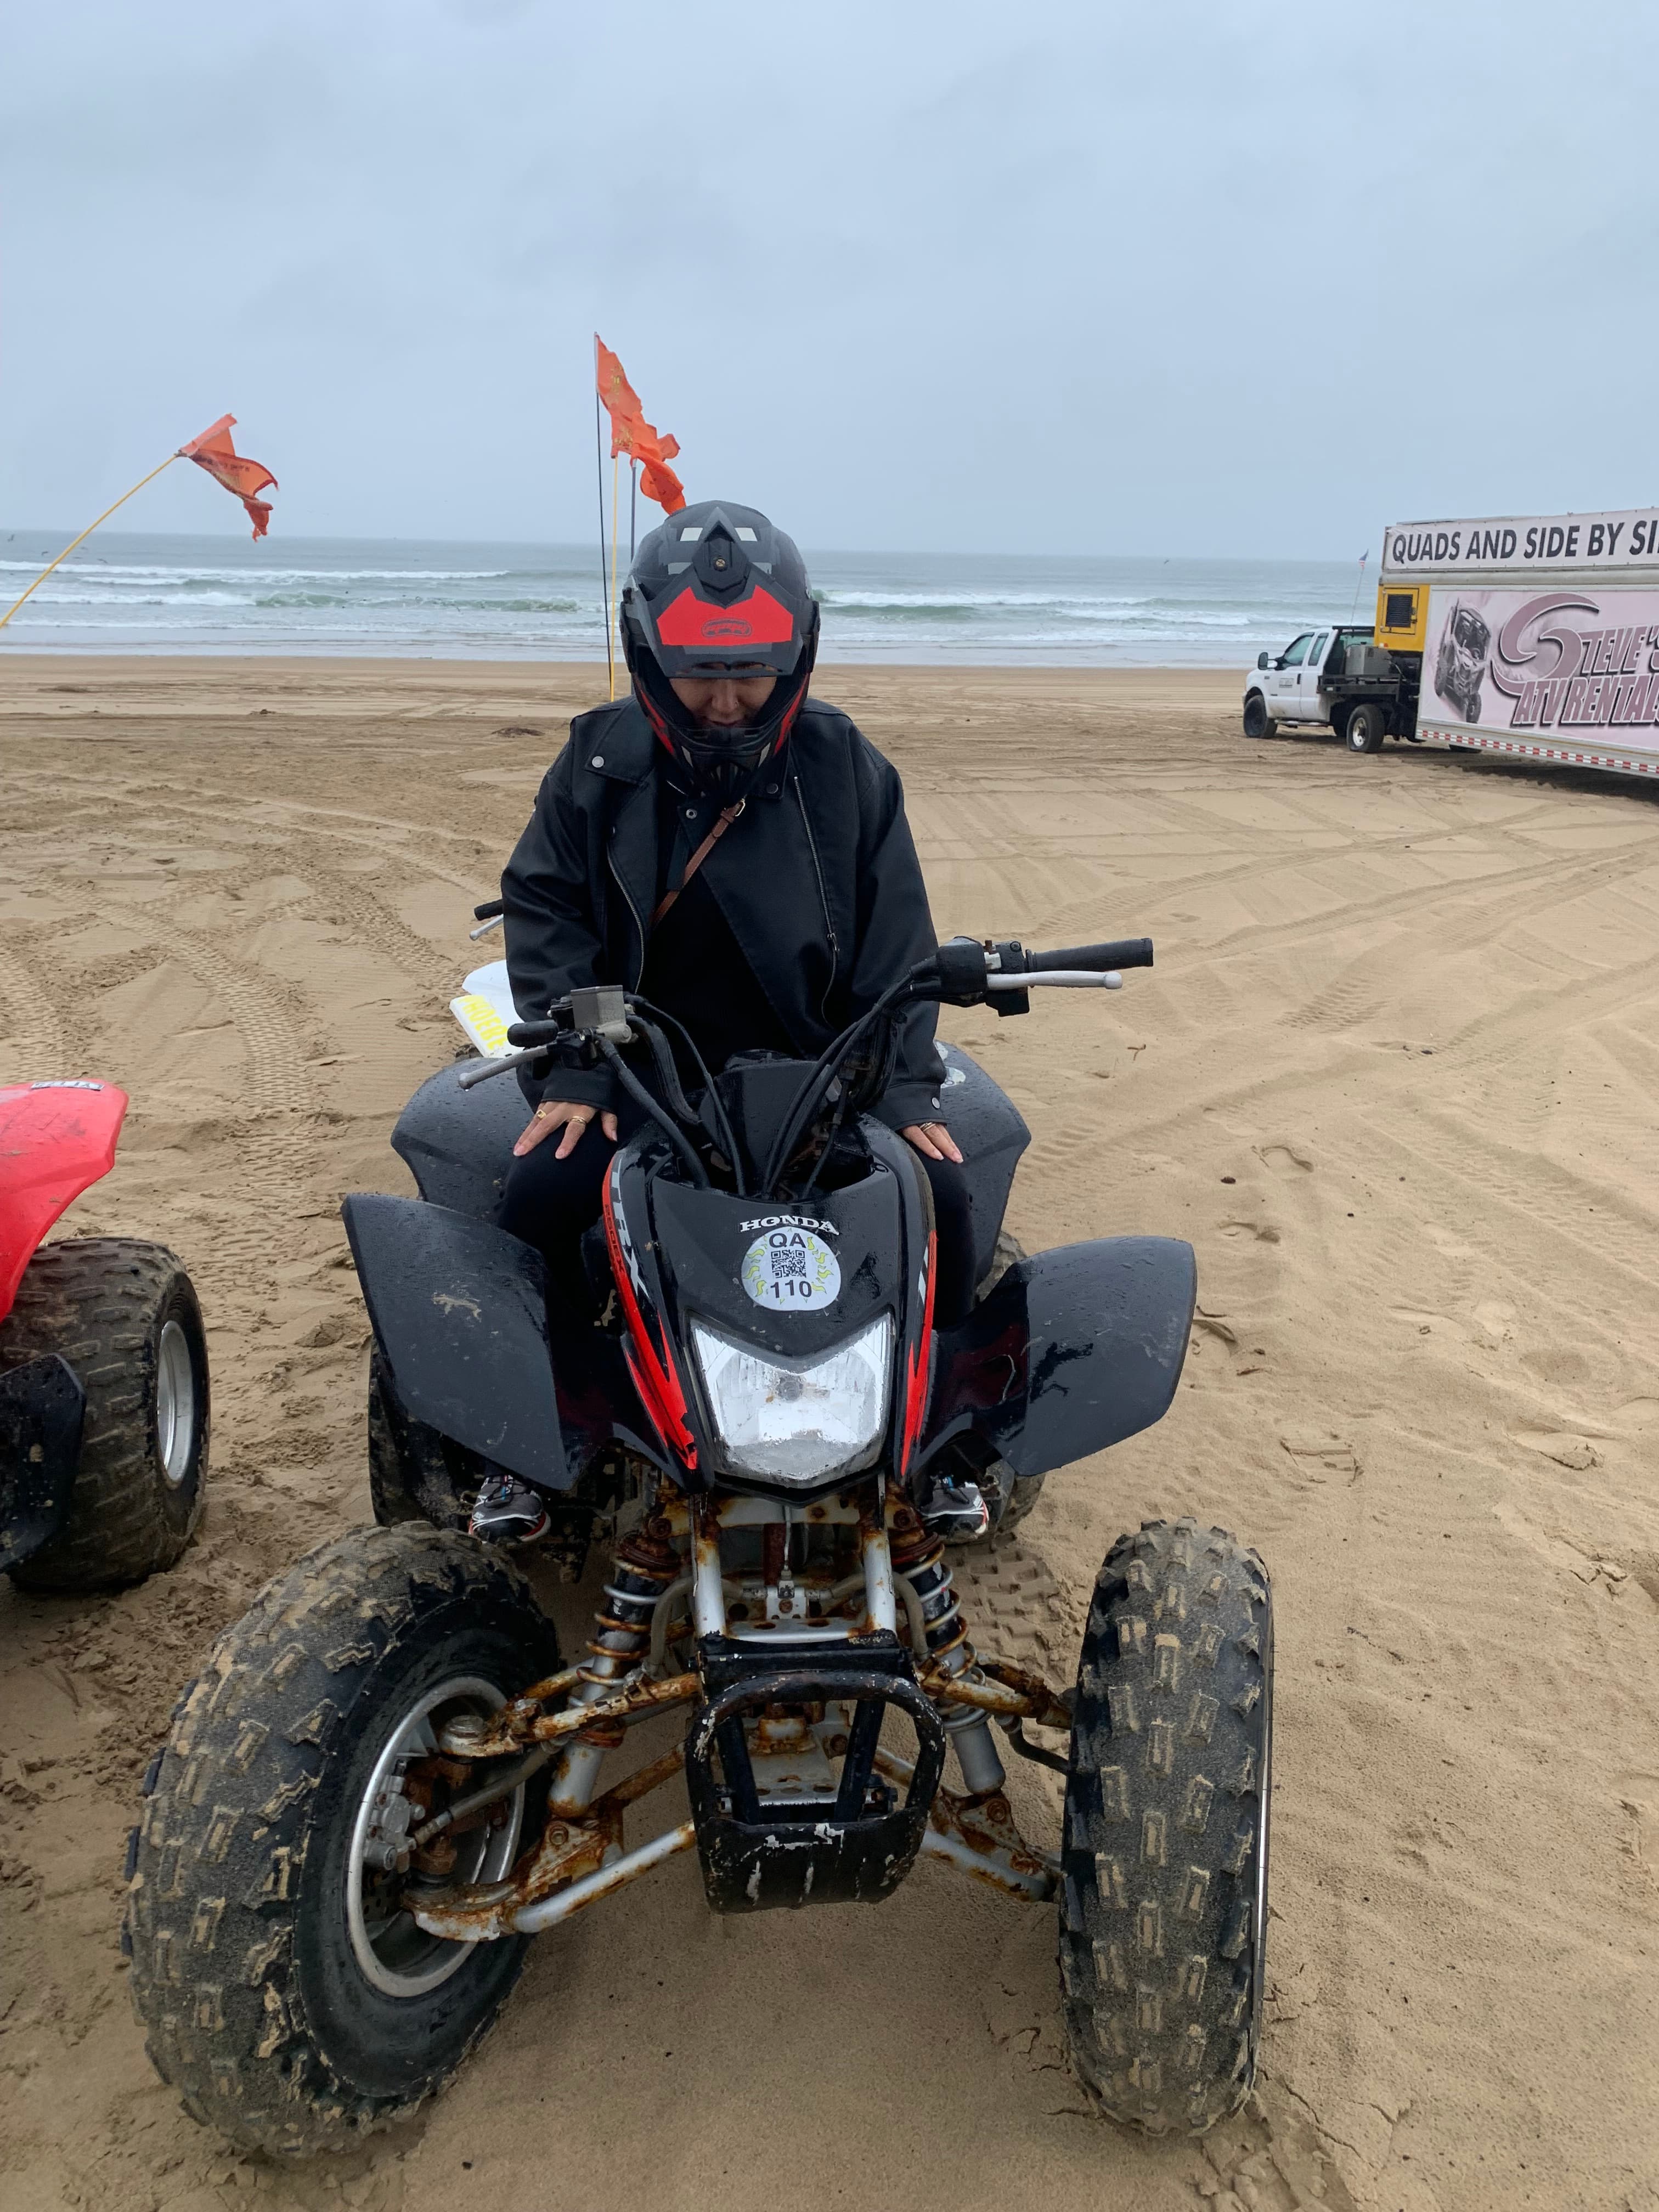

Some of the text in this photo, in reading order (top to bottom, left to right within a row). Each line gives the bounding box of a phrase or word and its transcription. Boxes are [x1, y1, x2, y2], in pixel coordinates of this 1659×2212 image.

[1392, 520, 1659, 563] QUADS AND SIDE BY SI
[1512, 672, 1659, 725] ATV RENTAL
[740, 1215, 839, 1235] HONDA
[769, 1233, 806, 1248] QA
[770, 1279, 812, 1299] 110
